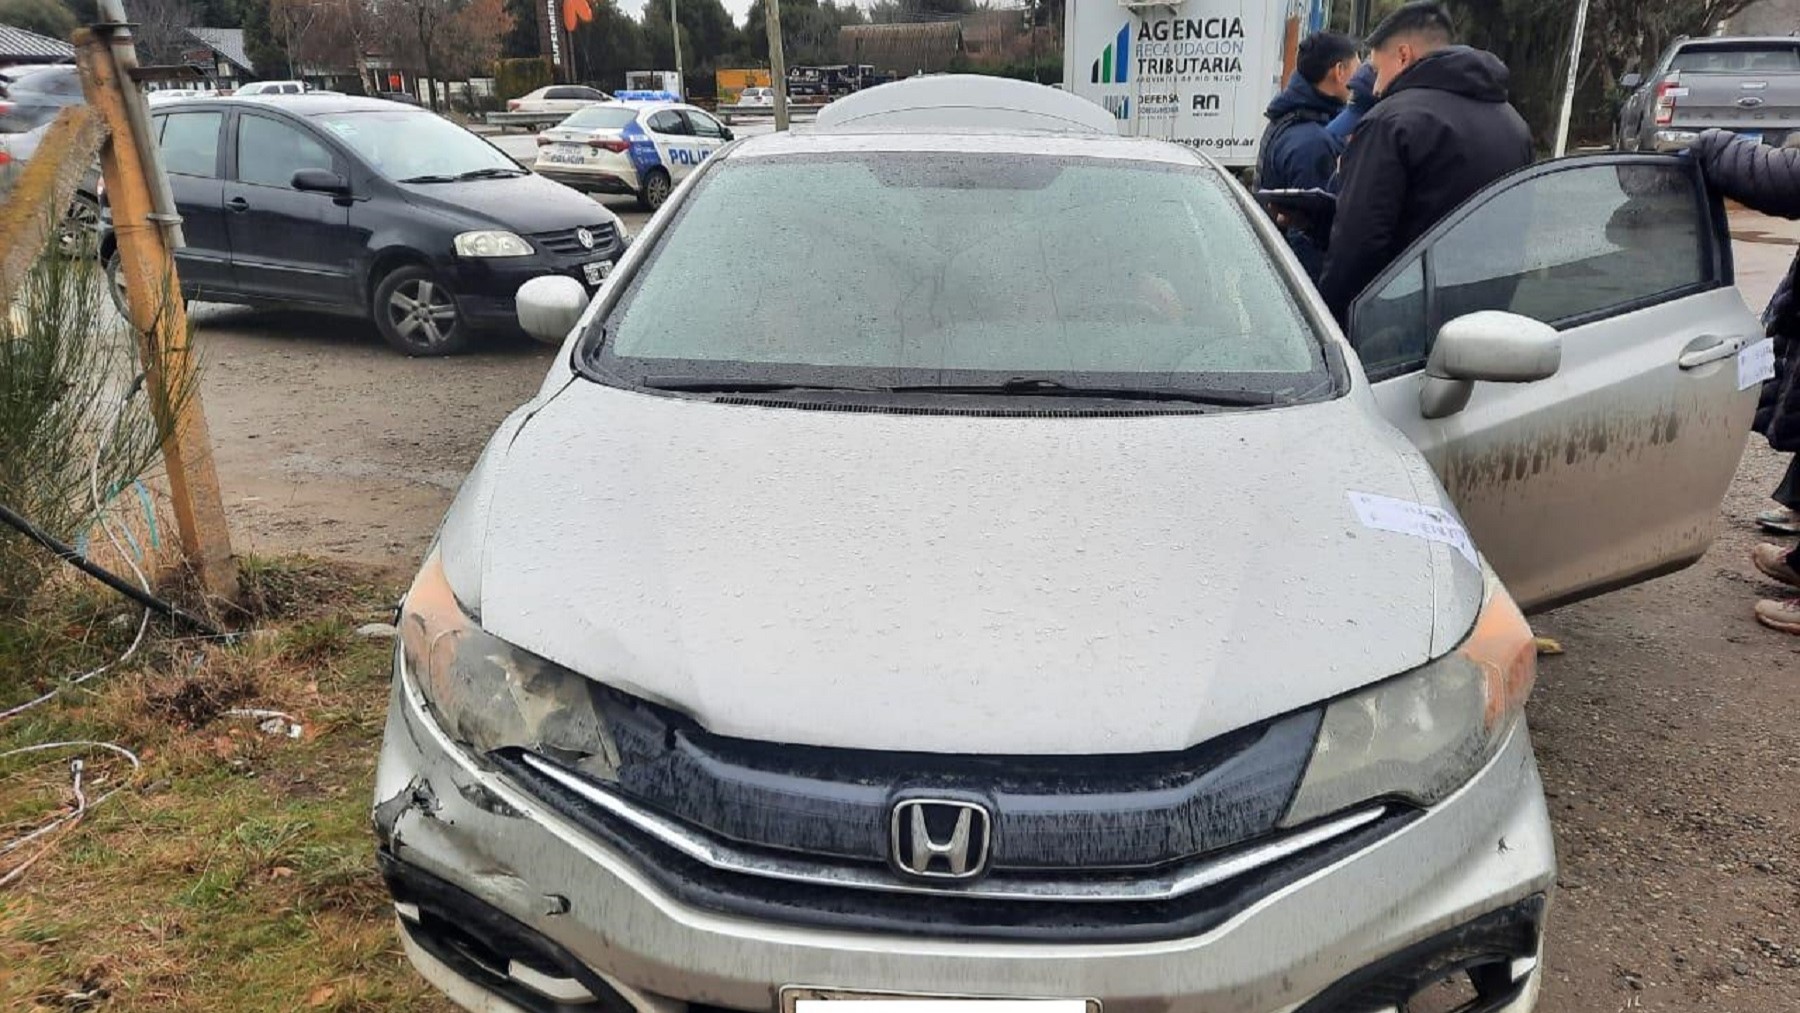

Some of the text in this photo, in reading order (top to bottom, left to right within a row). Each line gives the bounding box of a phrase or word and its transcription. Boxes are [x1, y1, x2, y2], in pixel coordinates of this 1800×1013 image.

[1138, 17, 1244, 40] AGENCIA
[1138, 57, 1241, 74] TRIBUTARIA
[1138, 94, 1179, 104] DEFENSA
